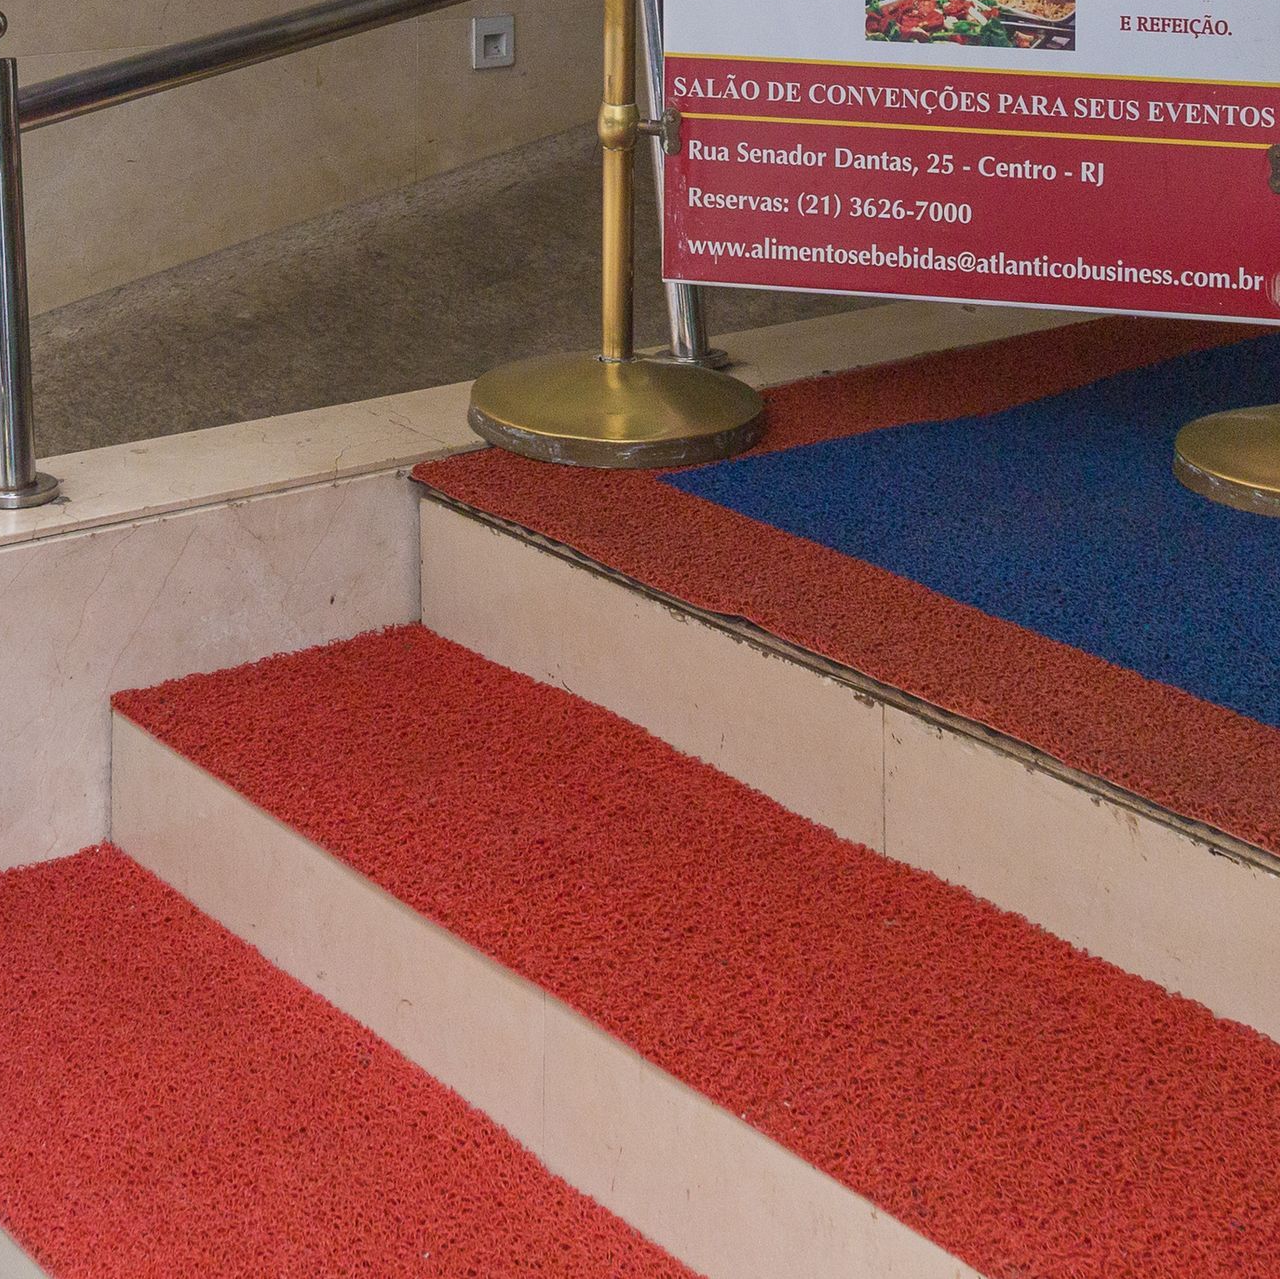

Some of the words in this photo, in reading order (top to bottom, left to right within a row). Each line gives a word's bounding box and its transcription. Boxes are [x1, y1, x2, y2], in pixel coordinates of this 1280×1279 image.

[1120, 16, 1131, 31] E
[1137, 15, 1232, 38] REFEIÇÃO.
[674, 74, 760, 100] SALÃO
[768, 82, 801, 102] DE
[809, 84, 990, 114] CONVENÇÕES
[999, 94, 1067, 116] PARA
[1074, 98, 1139, 120] SEUS
[1149, 102, 1275, 128] EVENTOS
[689, 140, 729, 161] Rua
[737, 142, 826, 166] Senador
[835, 148, 918, 176] Dantas,
[927, 154, 953, 174] 25
[978, 156, 1056, 180] Centro
[1081, 162, 1104, 186] RJ
[689, 187, 788, 212] Reservas:
[798, 193, 841, 217] (21)
[850, 197, 972, 223] 3626-7000
[688, 238, 1265, 290] www.alimentosebebidas@atlanticobusiness.com.br
